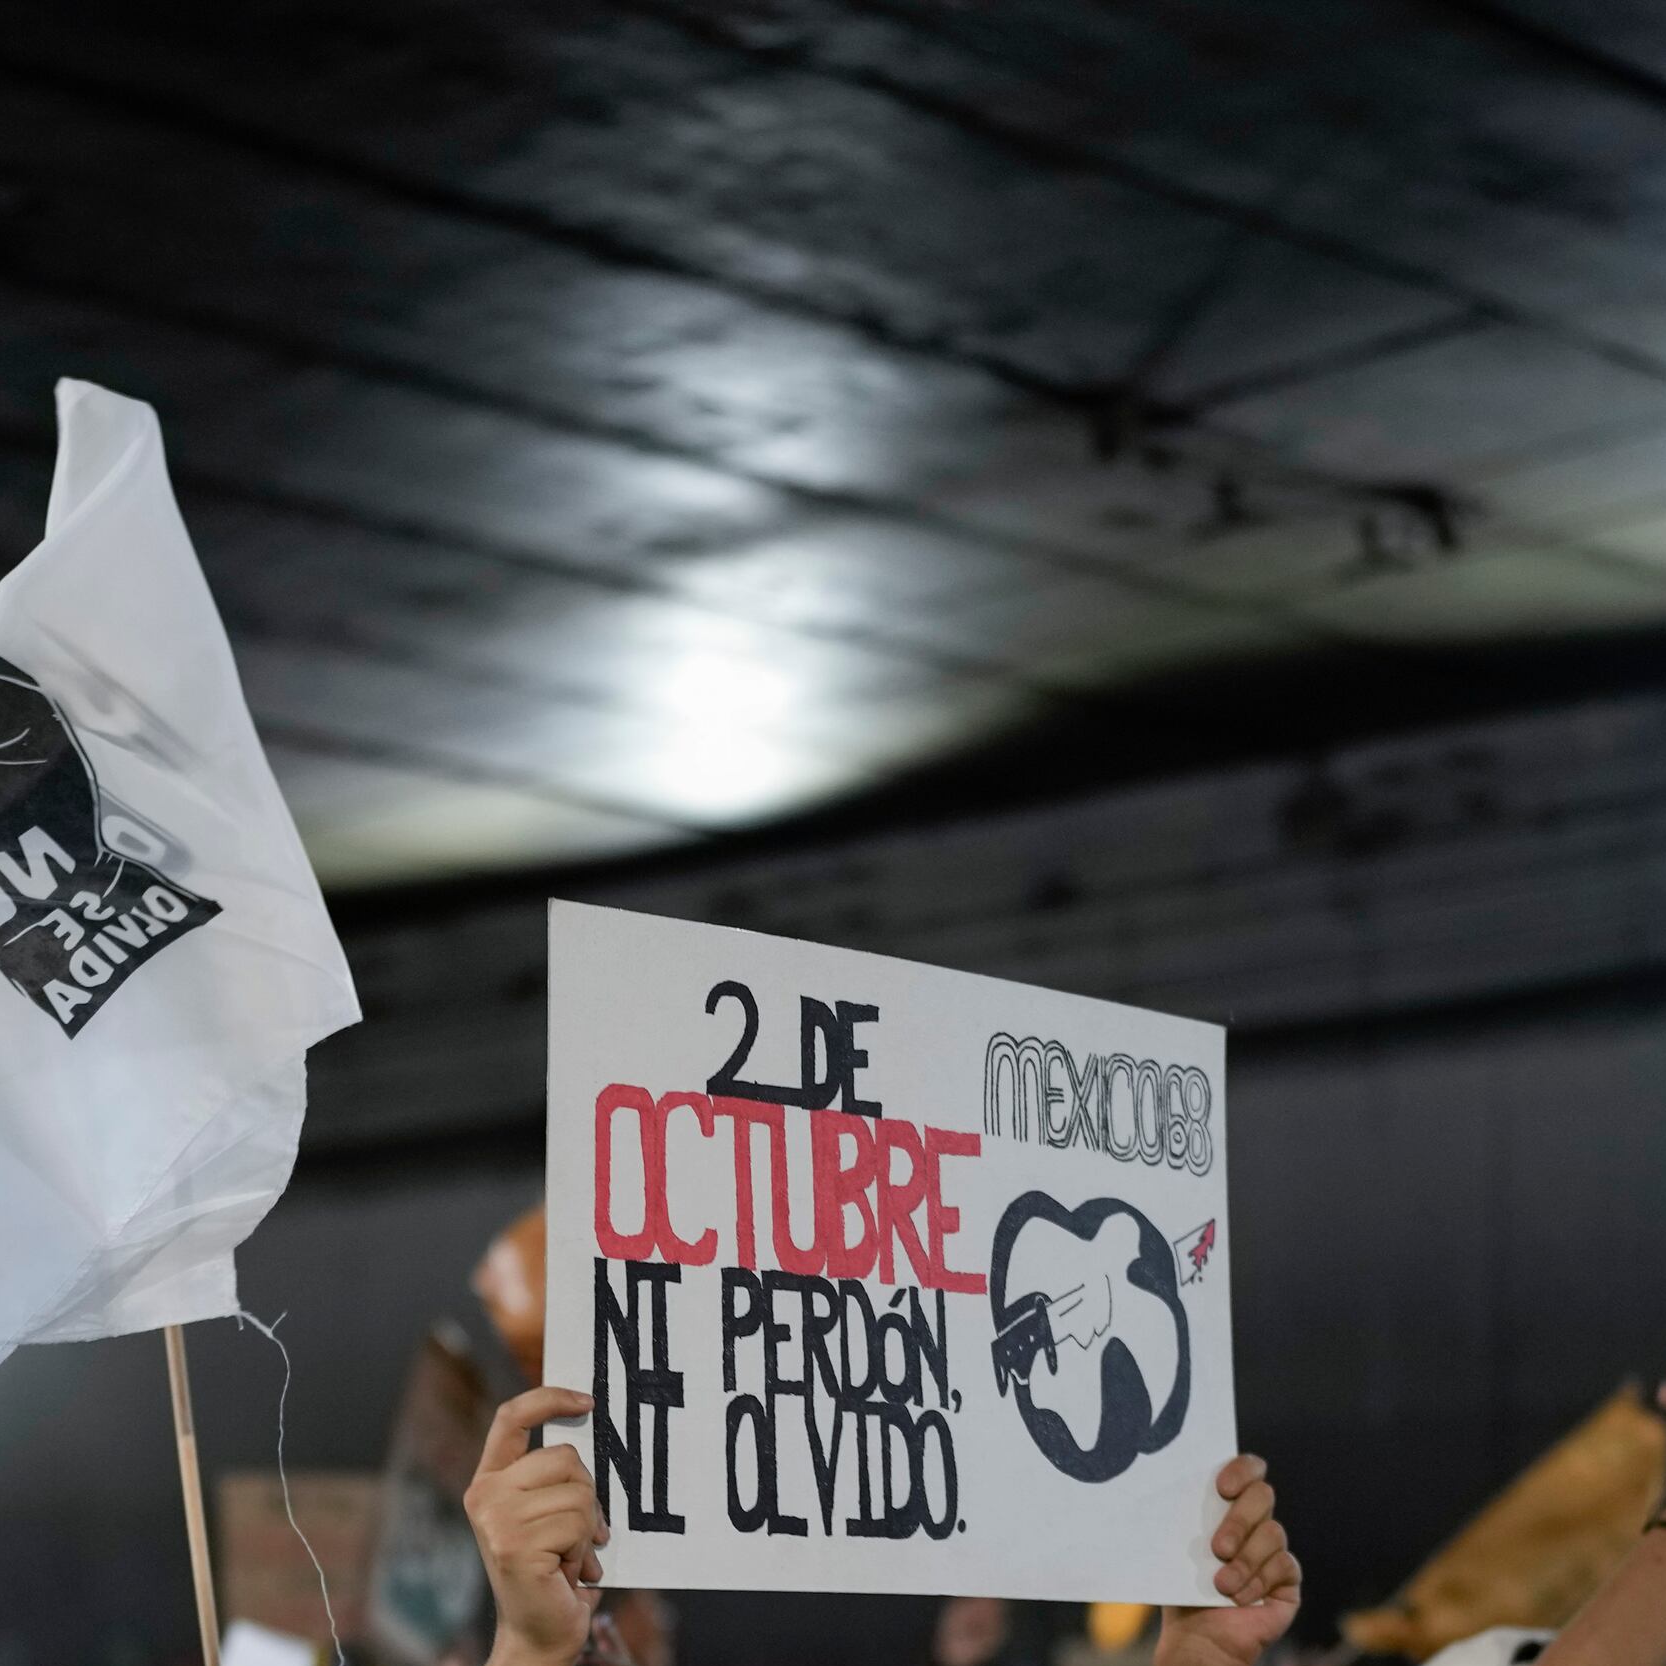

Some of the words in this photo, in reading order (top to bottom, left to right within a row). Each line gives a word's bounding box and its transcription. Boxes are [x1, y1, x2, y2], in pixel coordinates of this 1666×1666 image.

[705, 980, 801, 1099] 2
[800, 994, 882, 1119] DE
[595, 1085, 987, 1294] OCTUBRE
[594, 1259, 684, 1396] NI
[593, 1396, 686, 1535] NI
[725, 1395, 967, 1540] OLVIDO.
